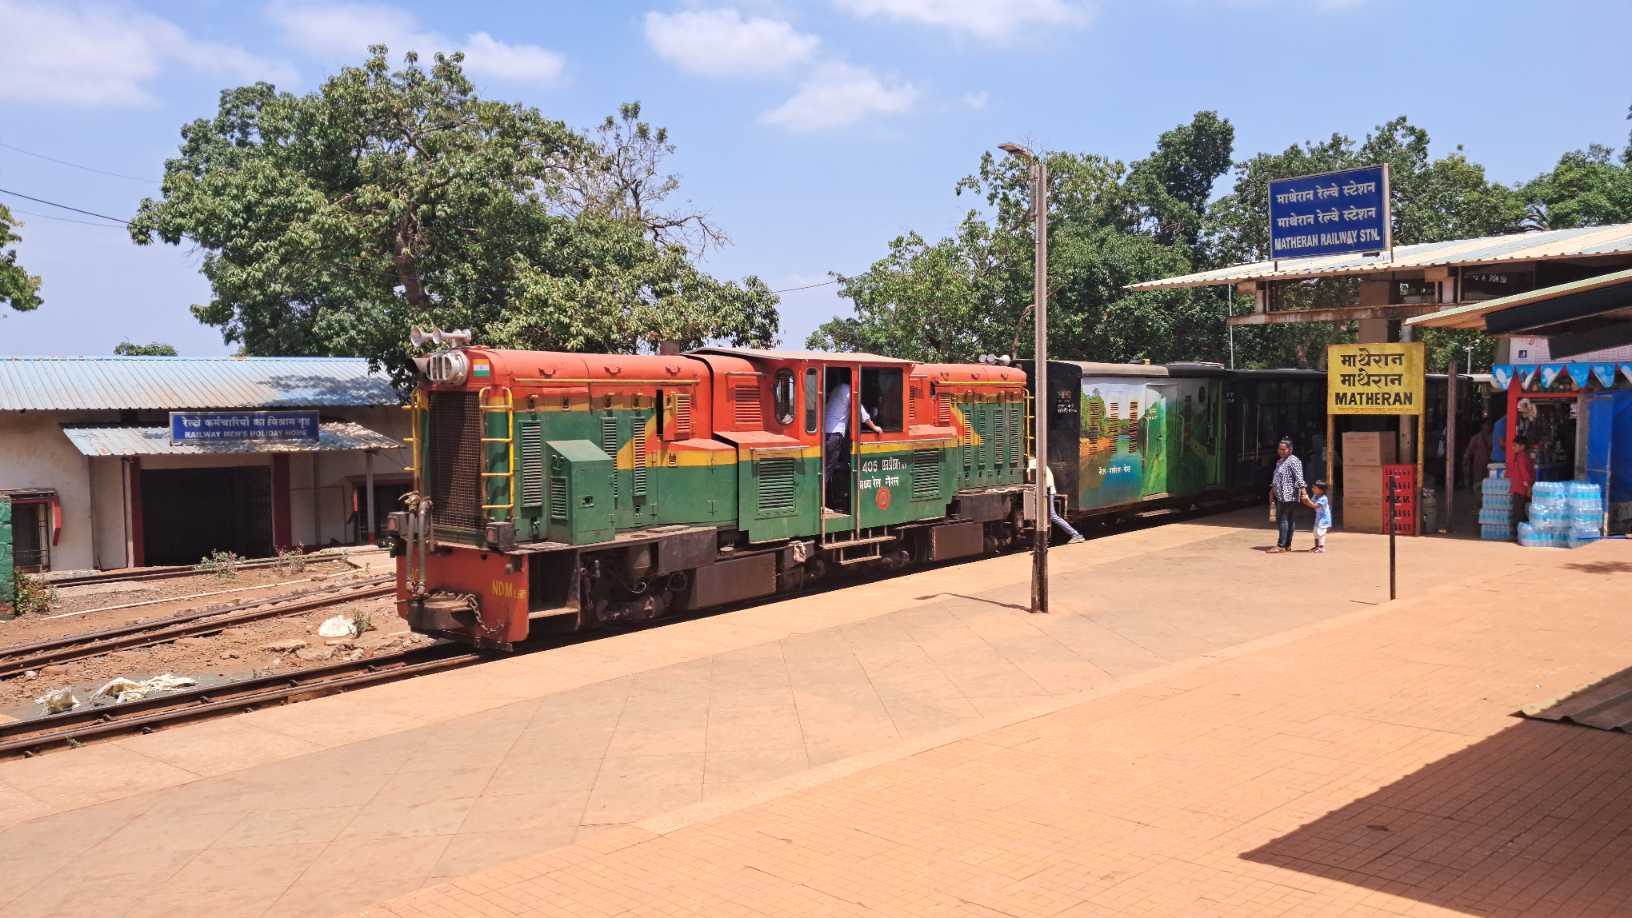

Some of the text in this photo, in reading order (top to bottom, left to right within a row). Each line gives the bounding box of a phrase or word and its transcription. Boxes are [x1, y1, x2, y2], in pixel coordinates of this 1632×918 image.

[1277, 180, 1376, 204] माथेरान रेल्वे स्टेशन
[1277, 206, 1376, 227] माथेरान रेल्वे स्टेशन
[1275, 234, 1319, 250] MATHERAN
[1321, 230, 1357, 246] RAILWAY
[1340, 348, 1404, 368] माथेरान
[1340, 368, 1403, 388] माथेरान
[1335, 392, 1413, 406] MATHERAN
[184, 431, 221, 439] RAILWAY
[862, 460, 878, 472] 405
[491, 578, 513, 597] NDM
